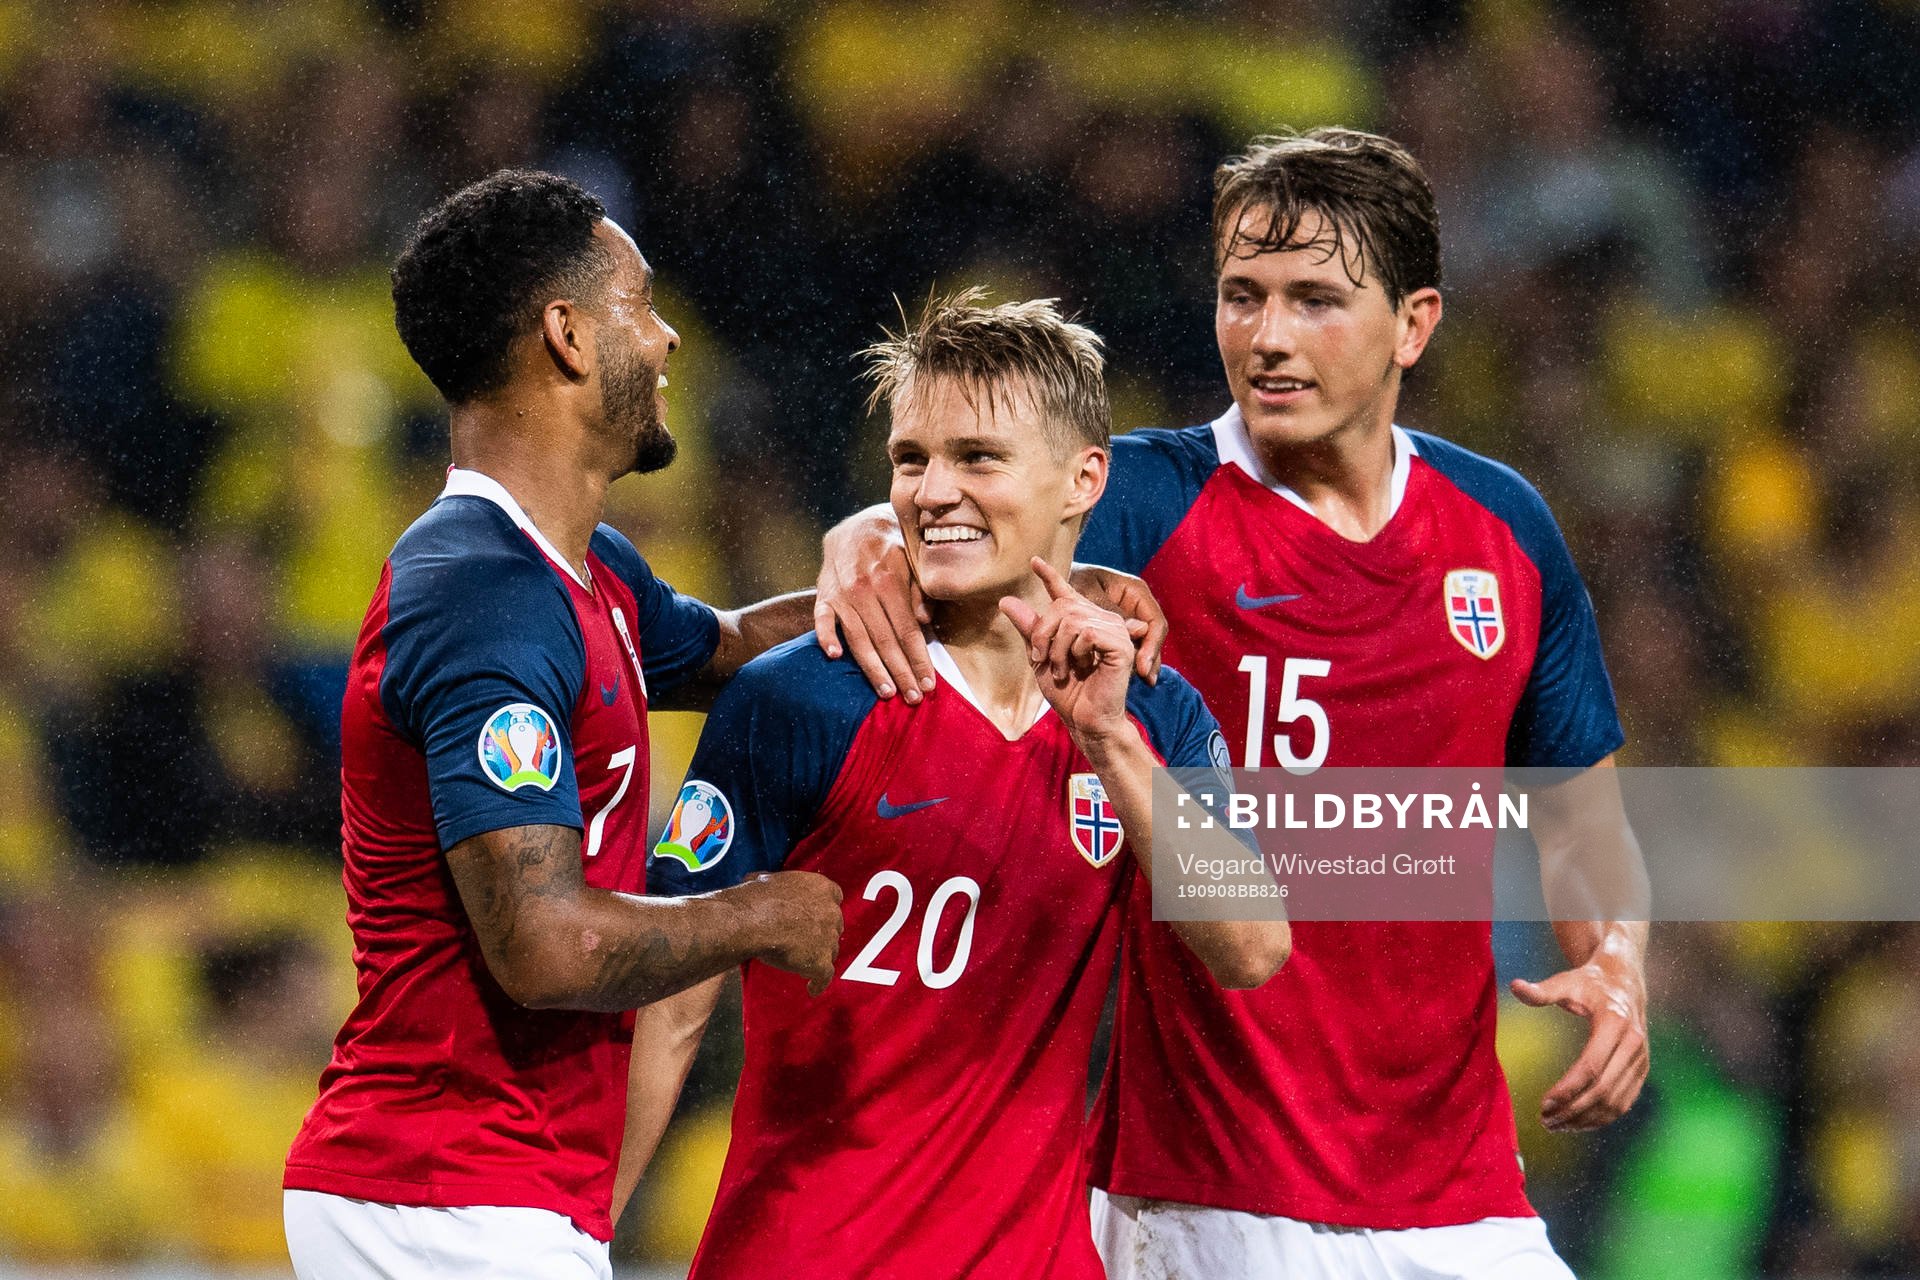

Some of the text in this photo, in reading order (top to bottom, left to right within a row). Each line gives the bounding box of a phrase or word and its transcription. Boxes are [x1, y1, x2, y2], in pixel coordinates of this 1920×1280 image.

[1237, 655, 1331, 776] 15
[586, 744, 636, 857] 7
[840, 870, 981, 989] 20
